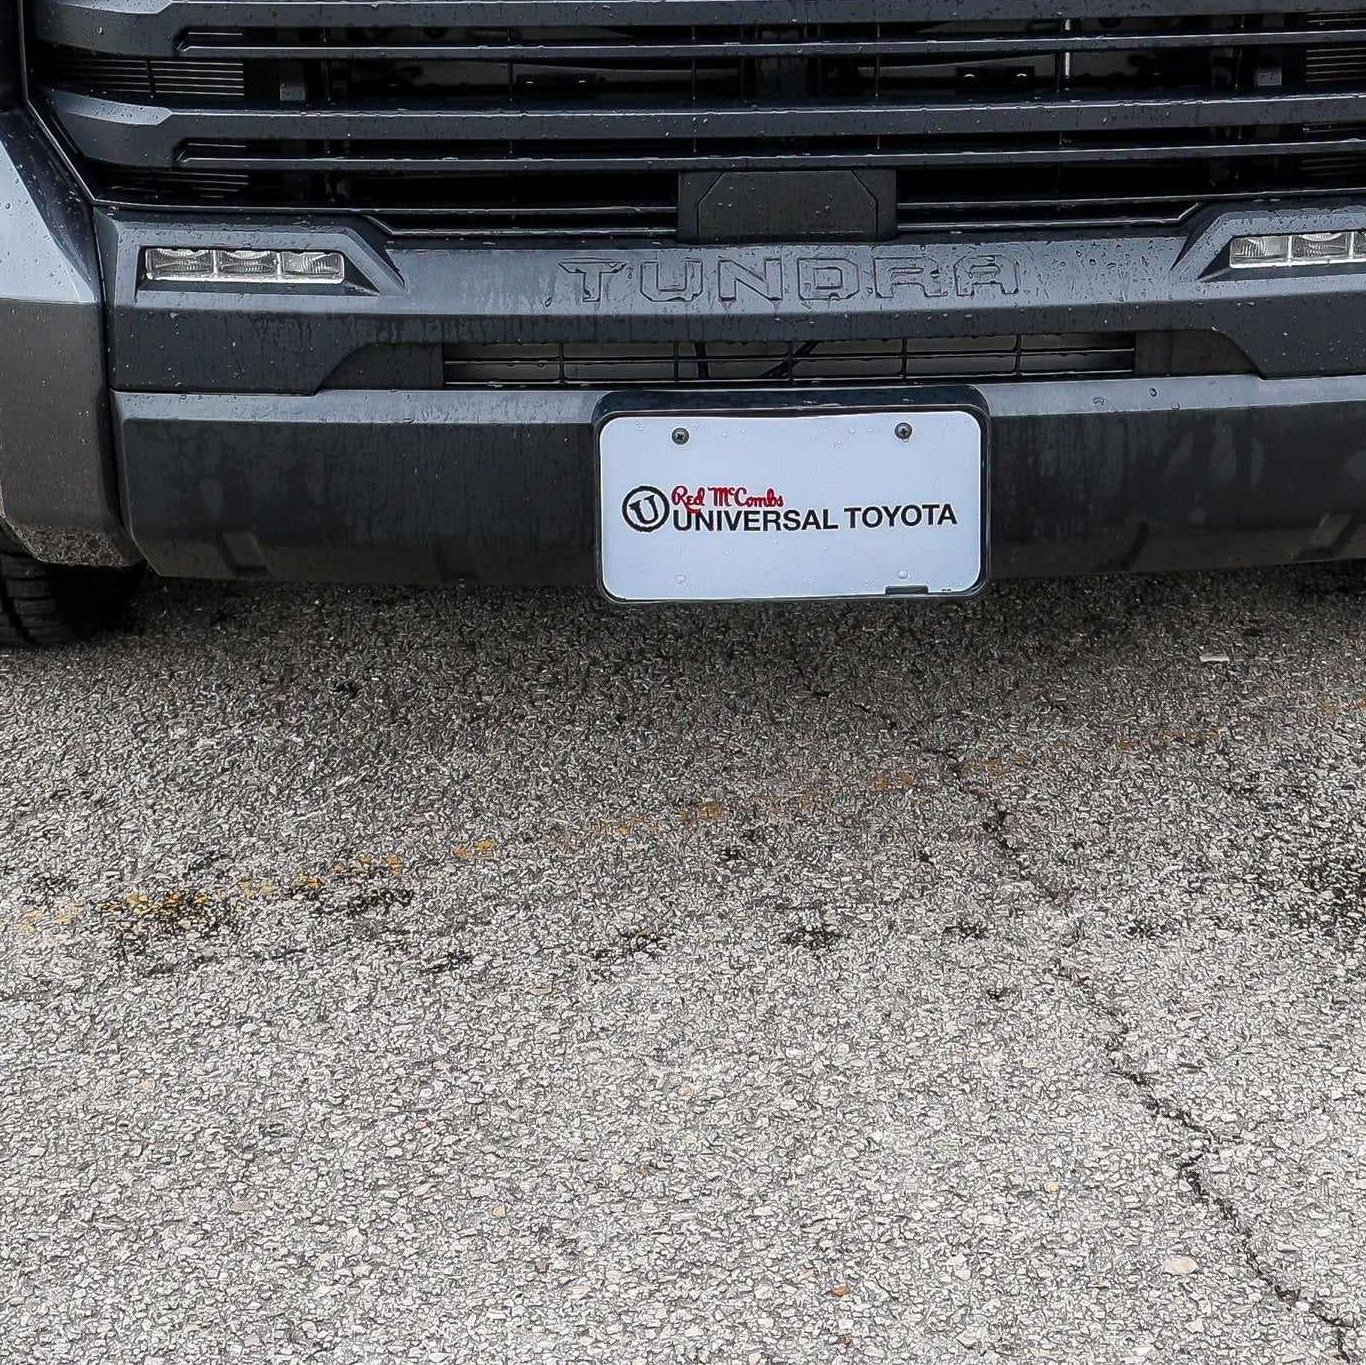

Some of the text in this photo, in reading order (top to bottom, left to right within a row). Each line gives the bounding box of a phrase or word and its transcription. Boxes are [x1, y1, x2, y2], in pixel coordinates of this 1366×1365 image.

[557, 254, 1021, 303] TUNDRA
[671, 485, 784, 514] Red McCombs
[673, 503, 959, 532] UNIVERSAL TOYOTA
